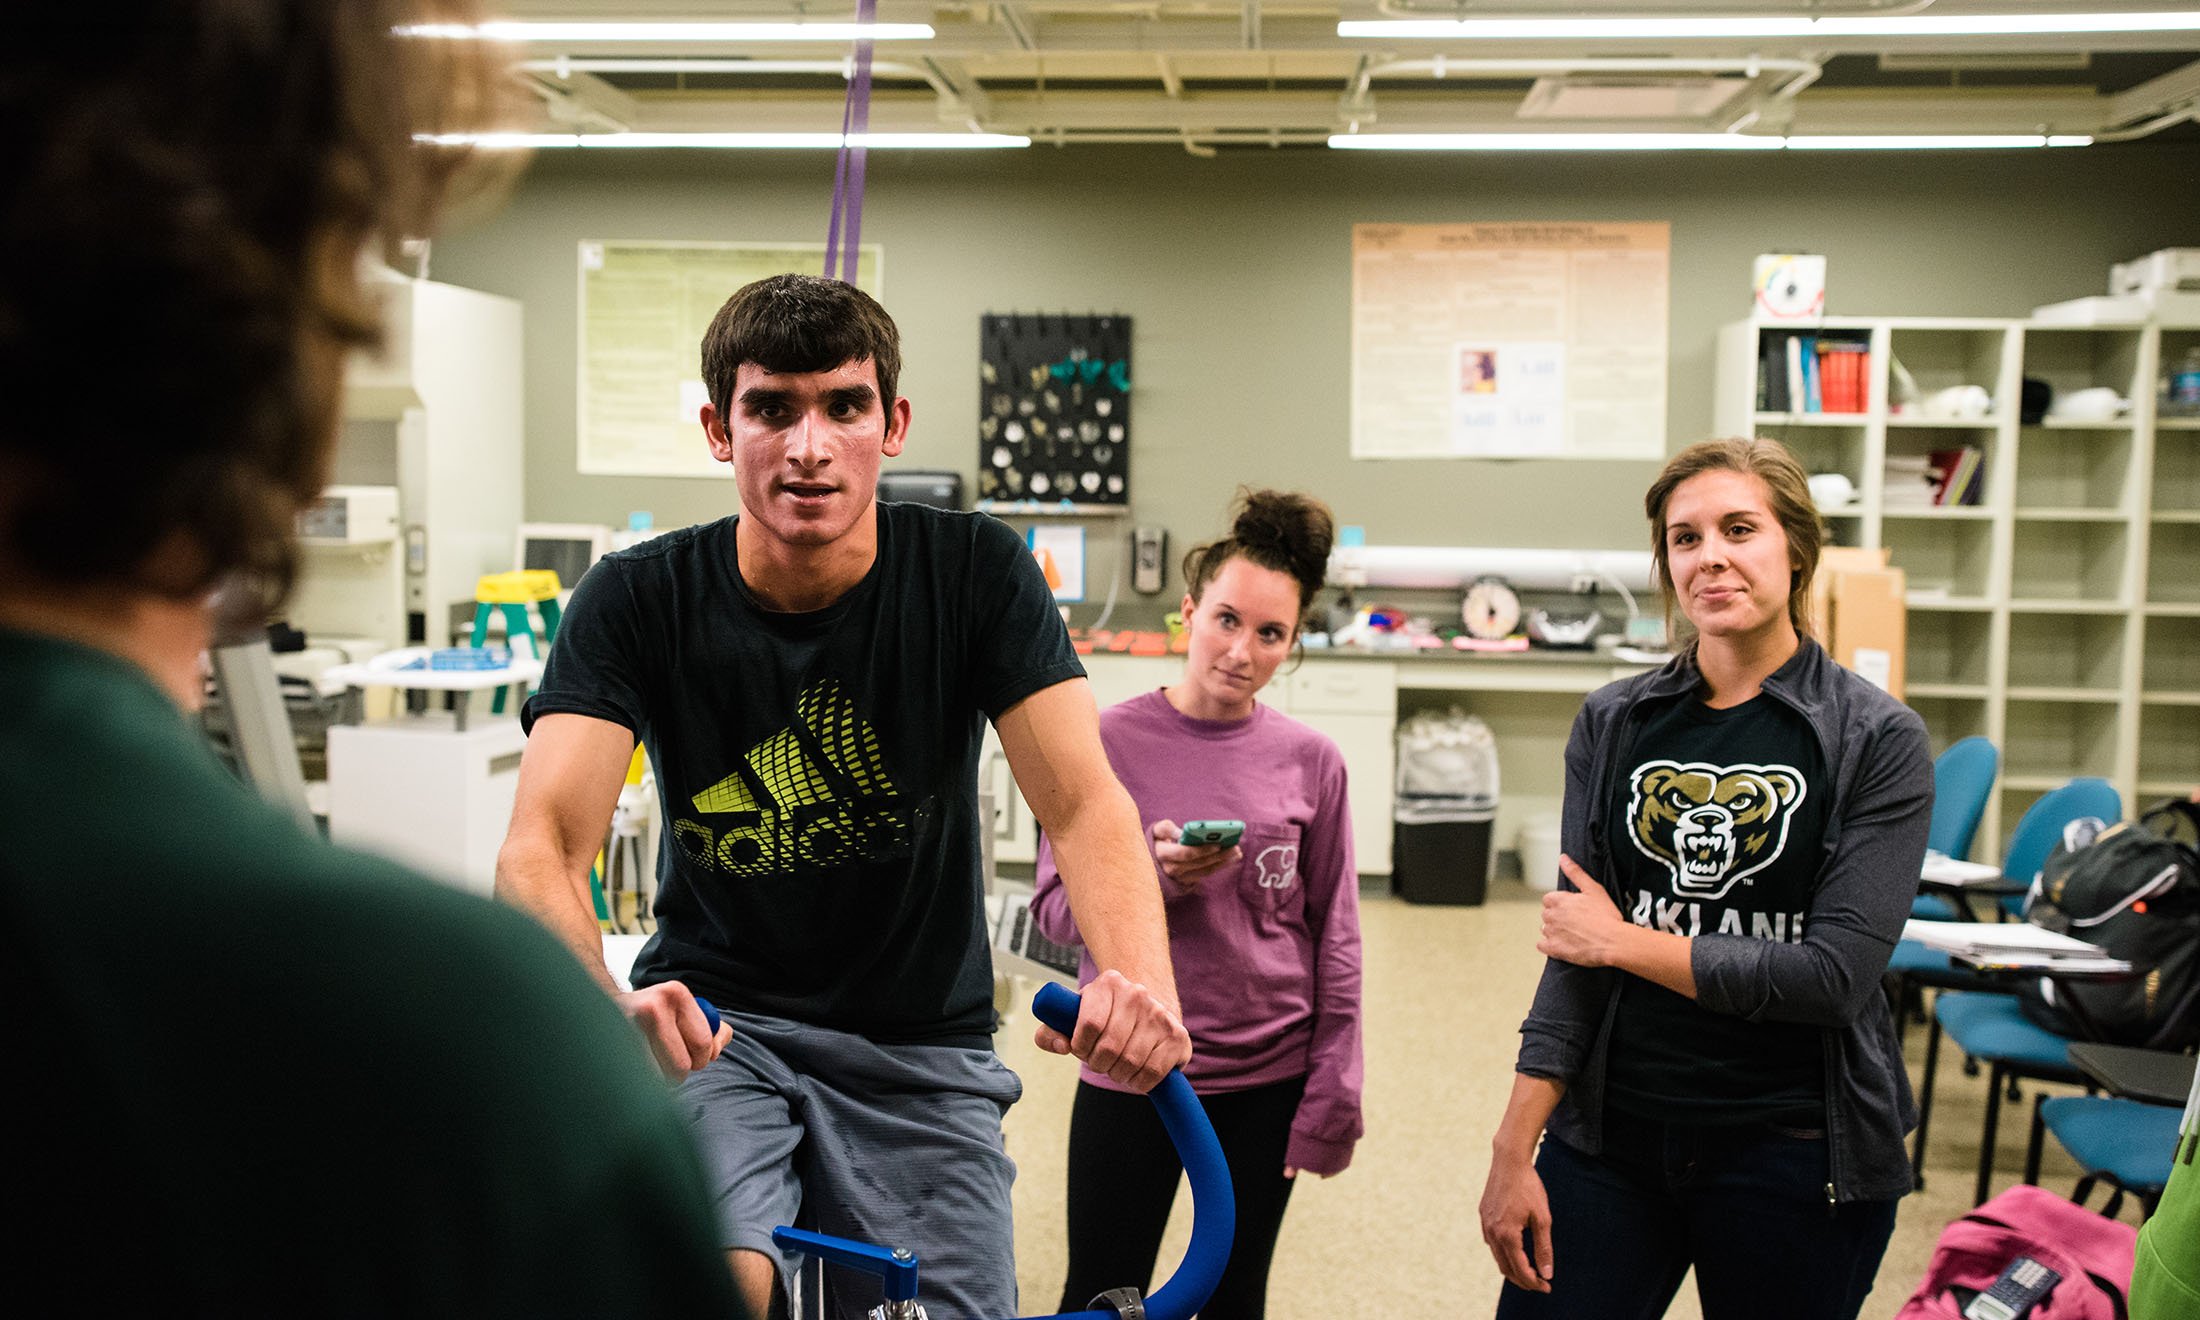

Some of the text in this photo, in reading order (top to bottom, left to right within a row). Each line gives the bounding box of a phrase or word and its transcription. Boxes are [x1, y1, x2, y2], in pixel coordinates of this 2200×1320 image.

[672, 796, 935, 878] adida
[1742, 878, 1754, 886] TM
[1625, 889, 1804, 944] AKLAN
